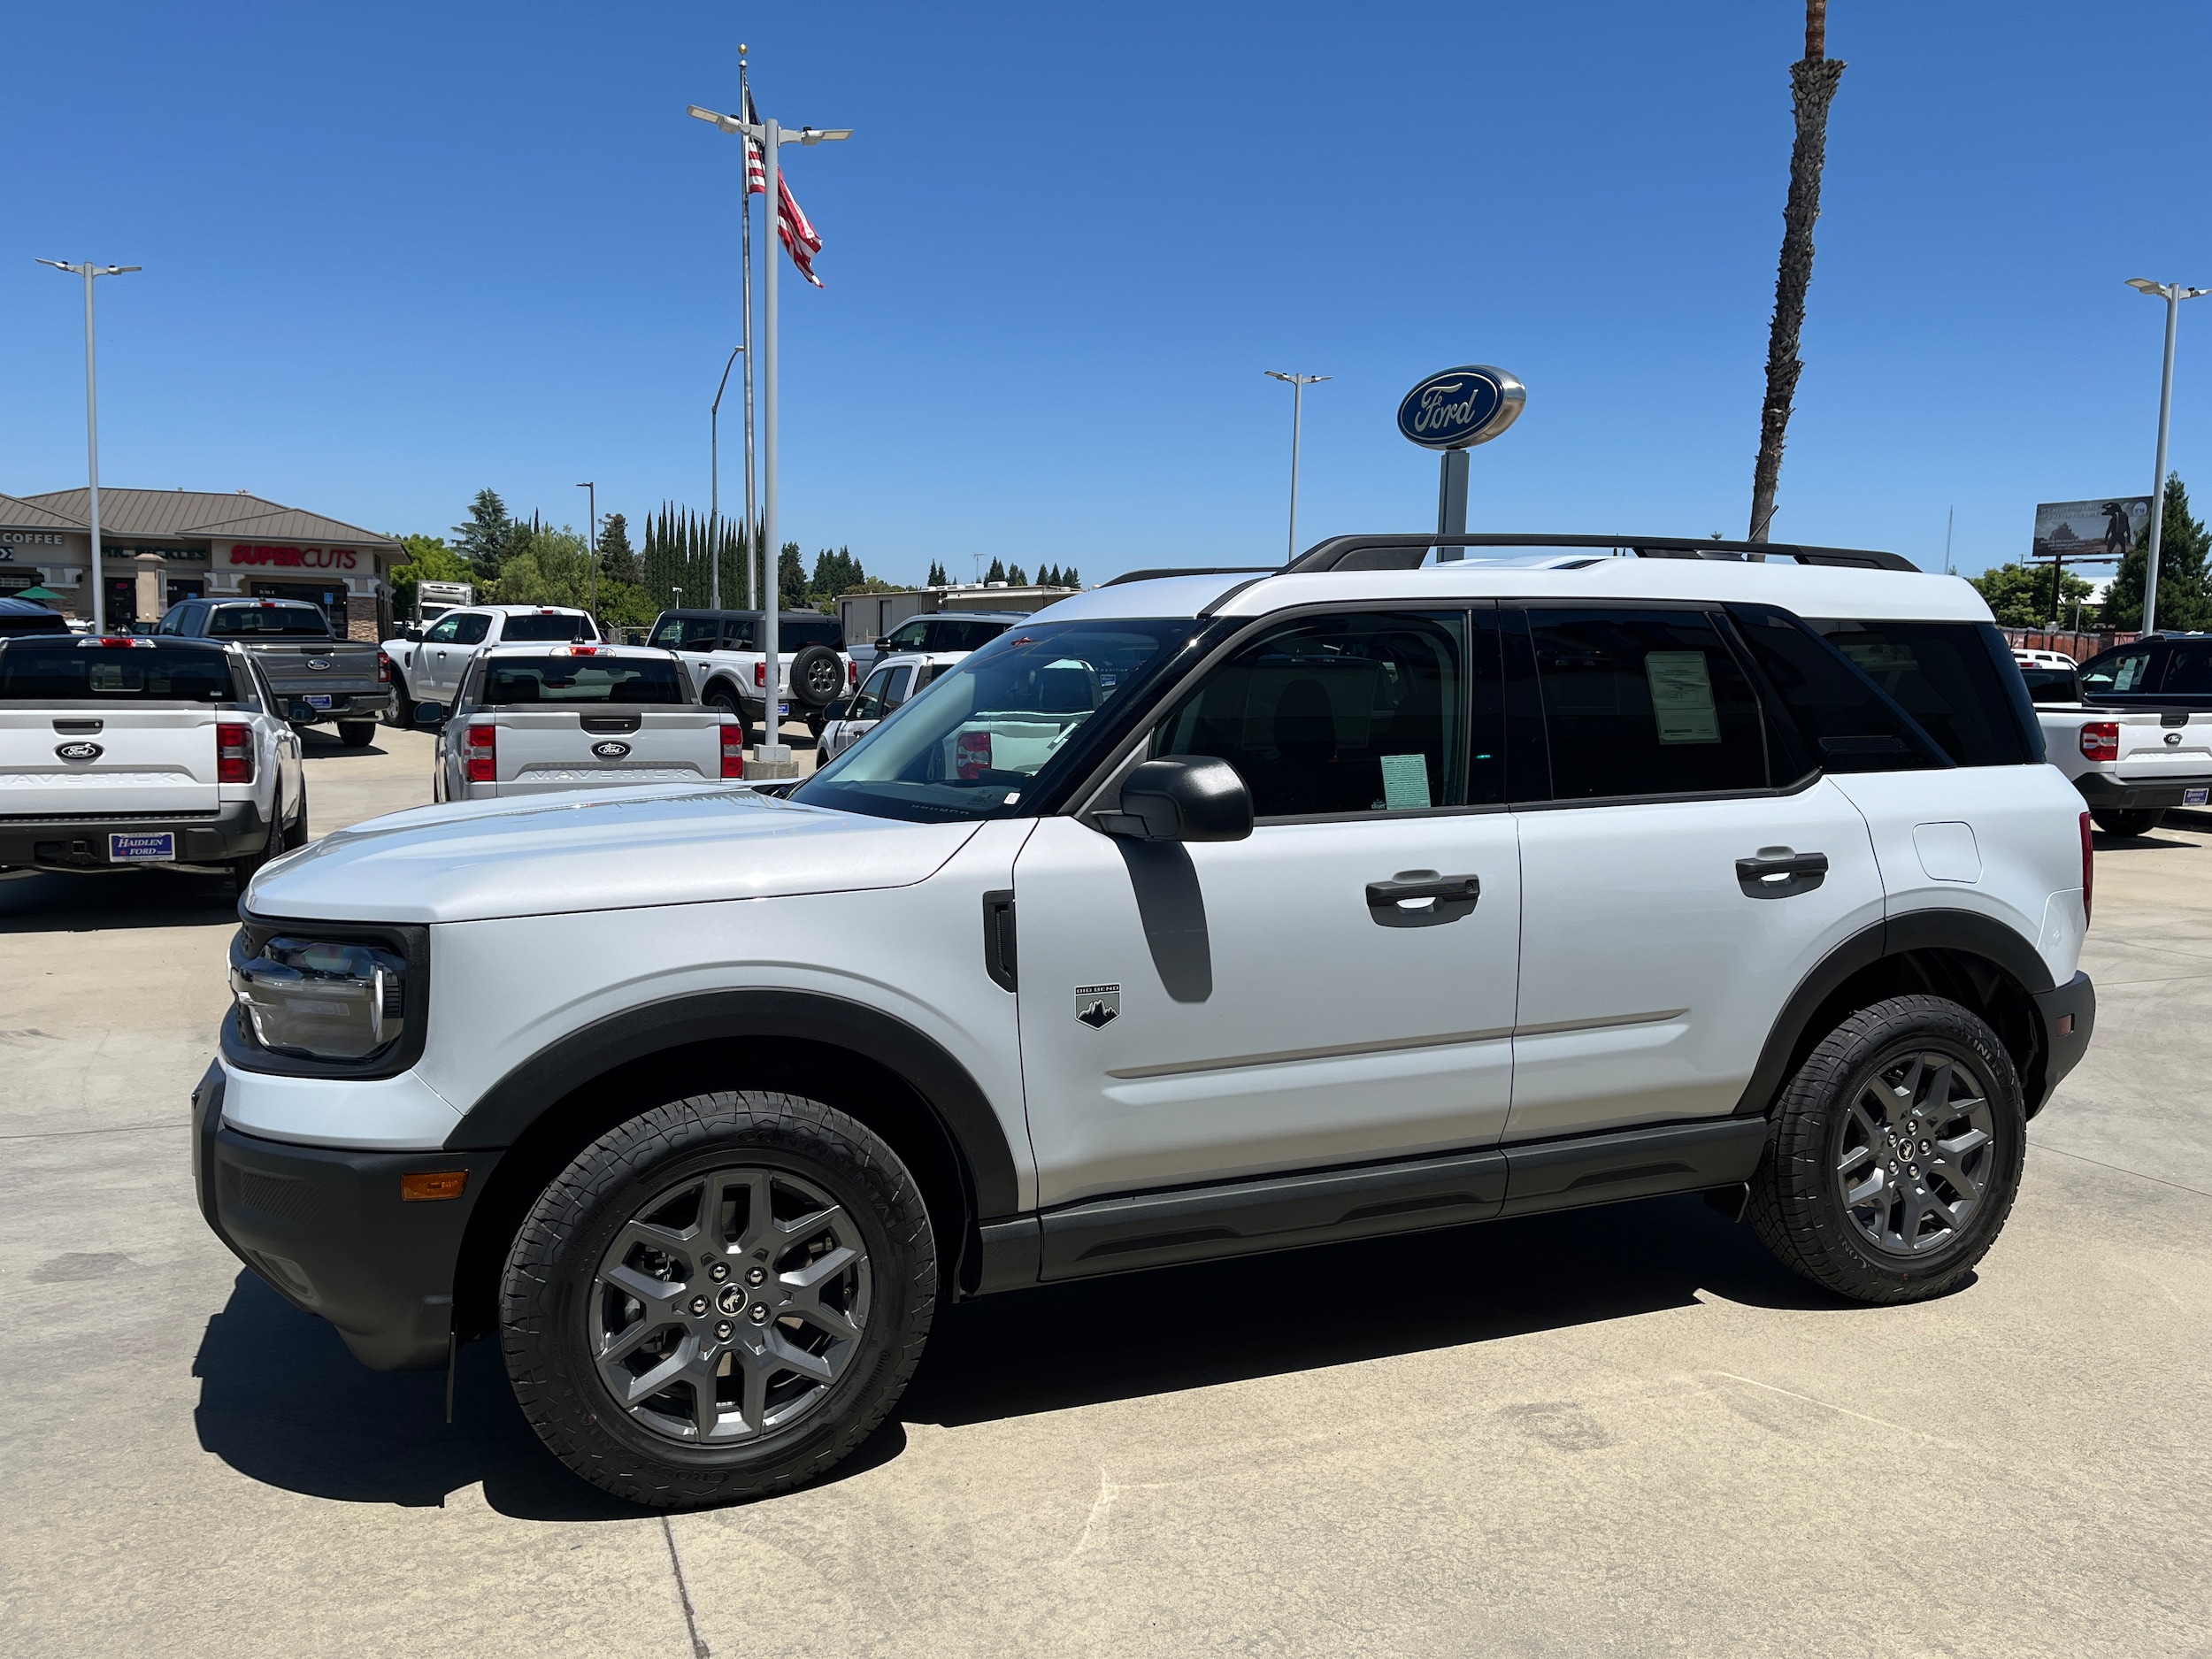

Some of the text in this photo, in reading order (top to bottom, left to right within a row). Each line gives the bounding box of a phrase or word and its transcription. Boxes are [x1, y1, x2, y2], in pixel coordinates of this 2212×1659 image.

[1414, 382, 1479, 432] Ford
[2, 533, 63, 545] COFFEE
[230, 544, 357, 569] SUPERCUTS
[67, 747, 89, 757] Ford
[0, 772, 179, 786] AVERICK
[531, 769, 690, 780] MAVERICK
[118, 838, 164, 848] HAIDLEN
[735, 1129, 897, 1237] CONTINENTAL
